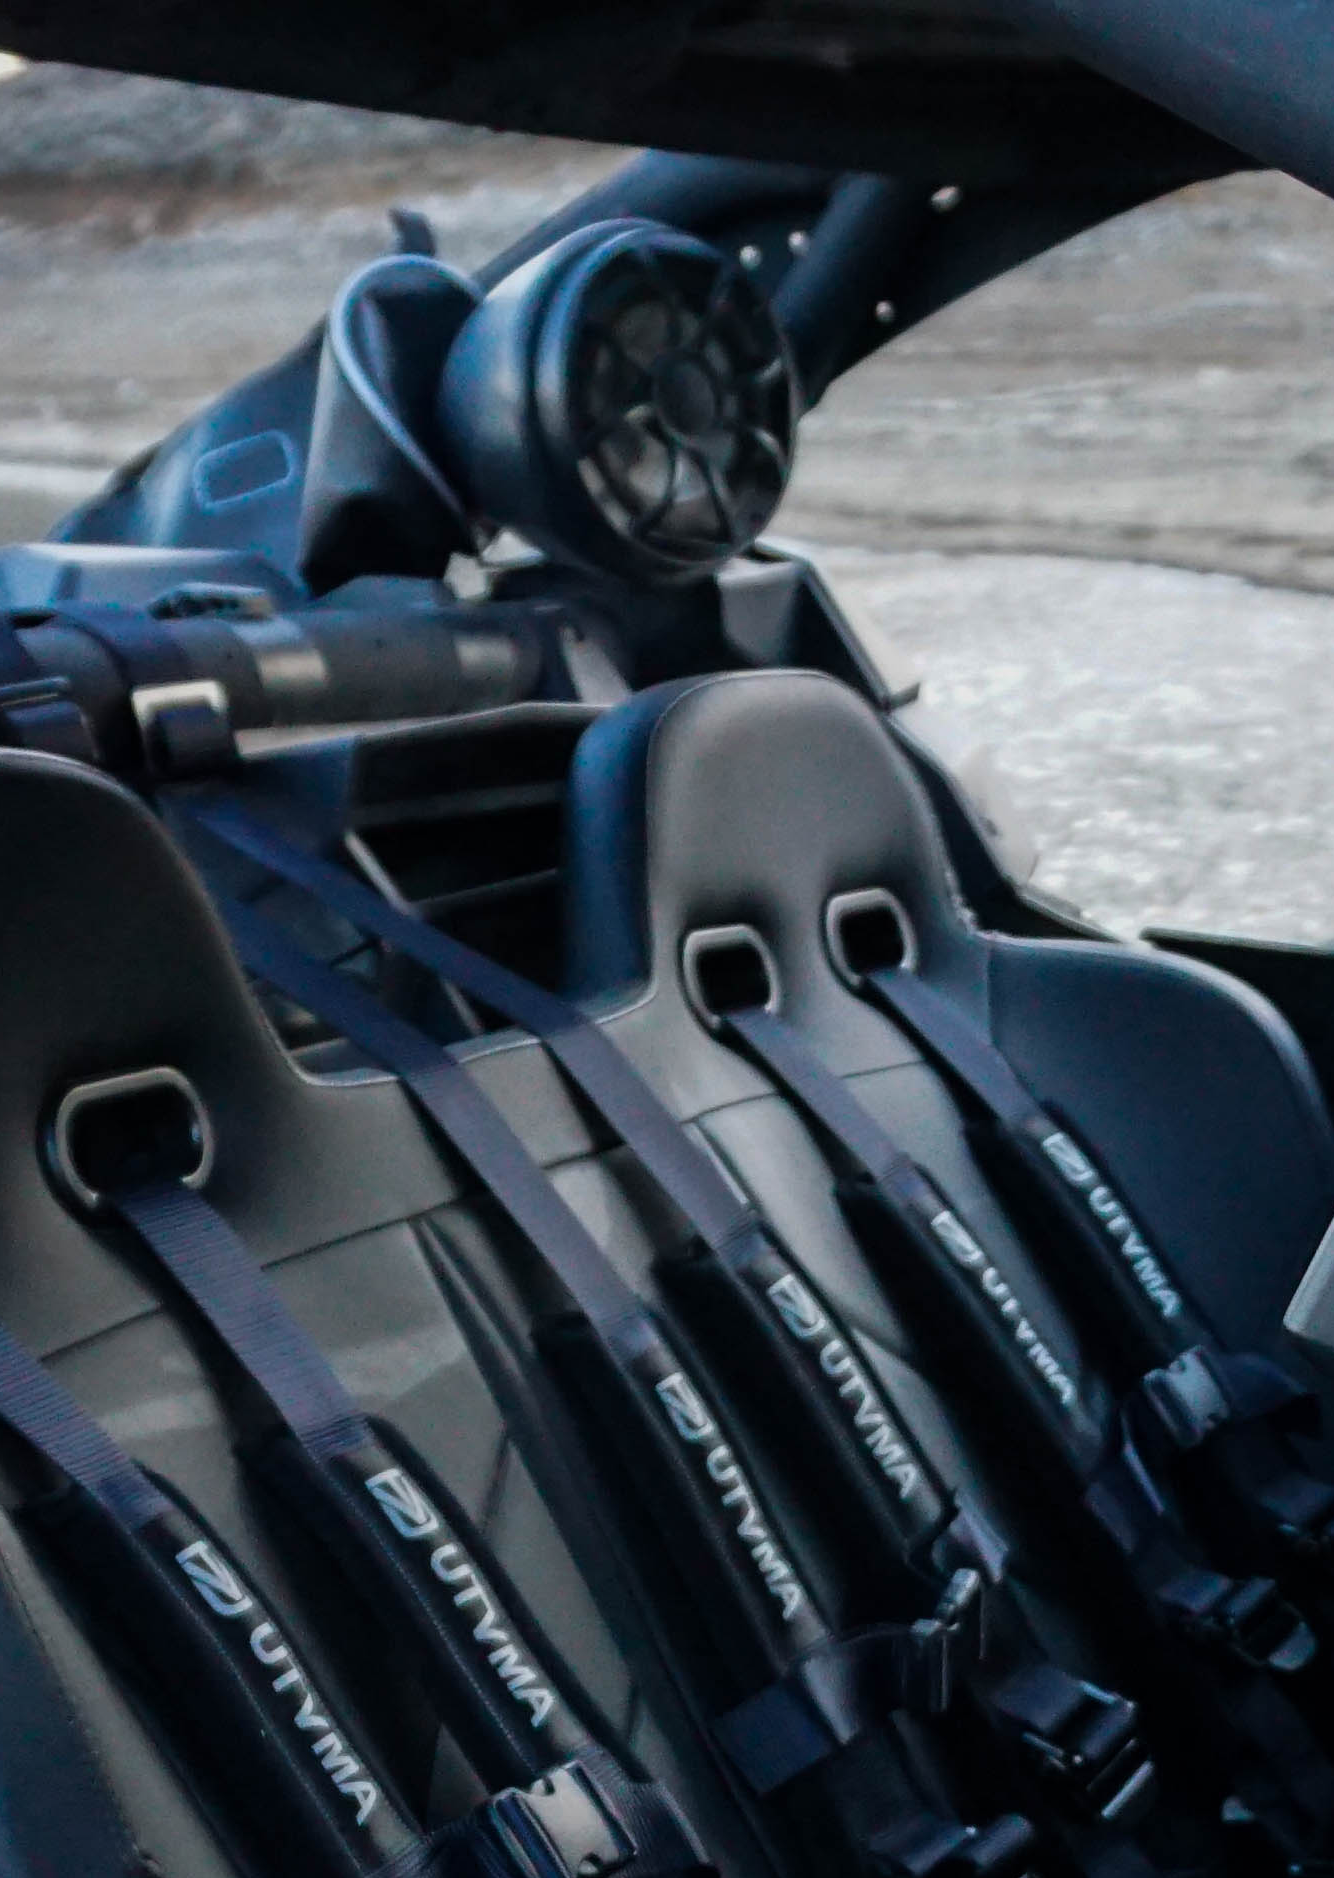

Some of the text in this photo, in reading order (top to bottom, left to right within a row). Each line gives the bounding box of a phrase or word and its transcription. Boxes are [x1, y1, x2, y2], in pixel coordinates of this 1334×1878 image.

[1089, 1186, 1180, 1318] UTVMA
[820, 1338, 916, 1499] UTVMA
[706, 1445, 803, 1620] UTVMA
[430, 1542, 555, 1728] UTVMA
[249, 1621, 377, 1826] UTVMA
